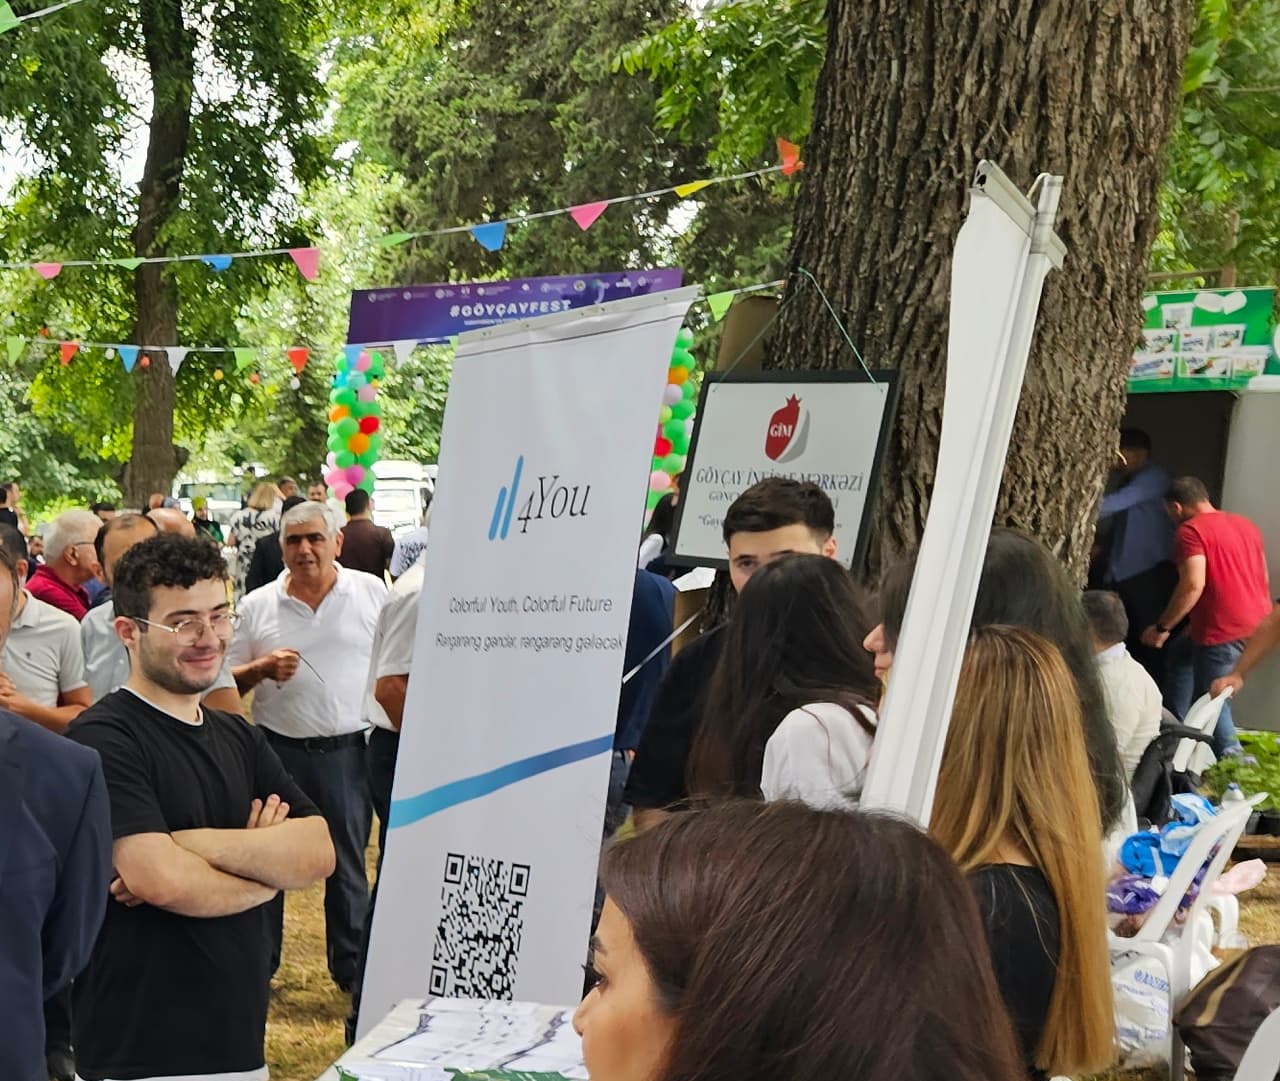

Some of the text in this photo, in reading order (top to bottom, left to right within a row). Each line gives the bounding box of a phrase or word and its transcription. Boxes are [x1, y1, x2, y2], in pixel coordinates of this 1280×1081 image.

[449, 299, 572, 318] #GÖYÇAYFEST
[696, 466, 742, 488] GÖYÇAY
[517, 475, 590, 533] 4You
[449, 597, 487, 614] Colorful
[522, 595, 566, 613] Colorful
[569, 595, 612, 613] Future
